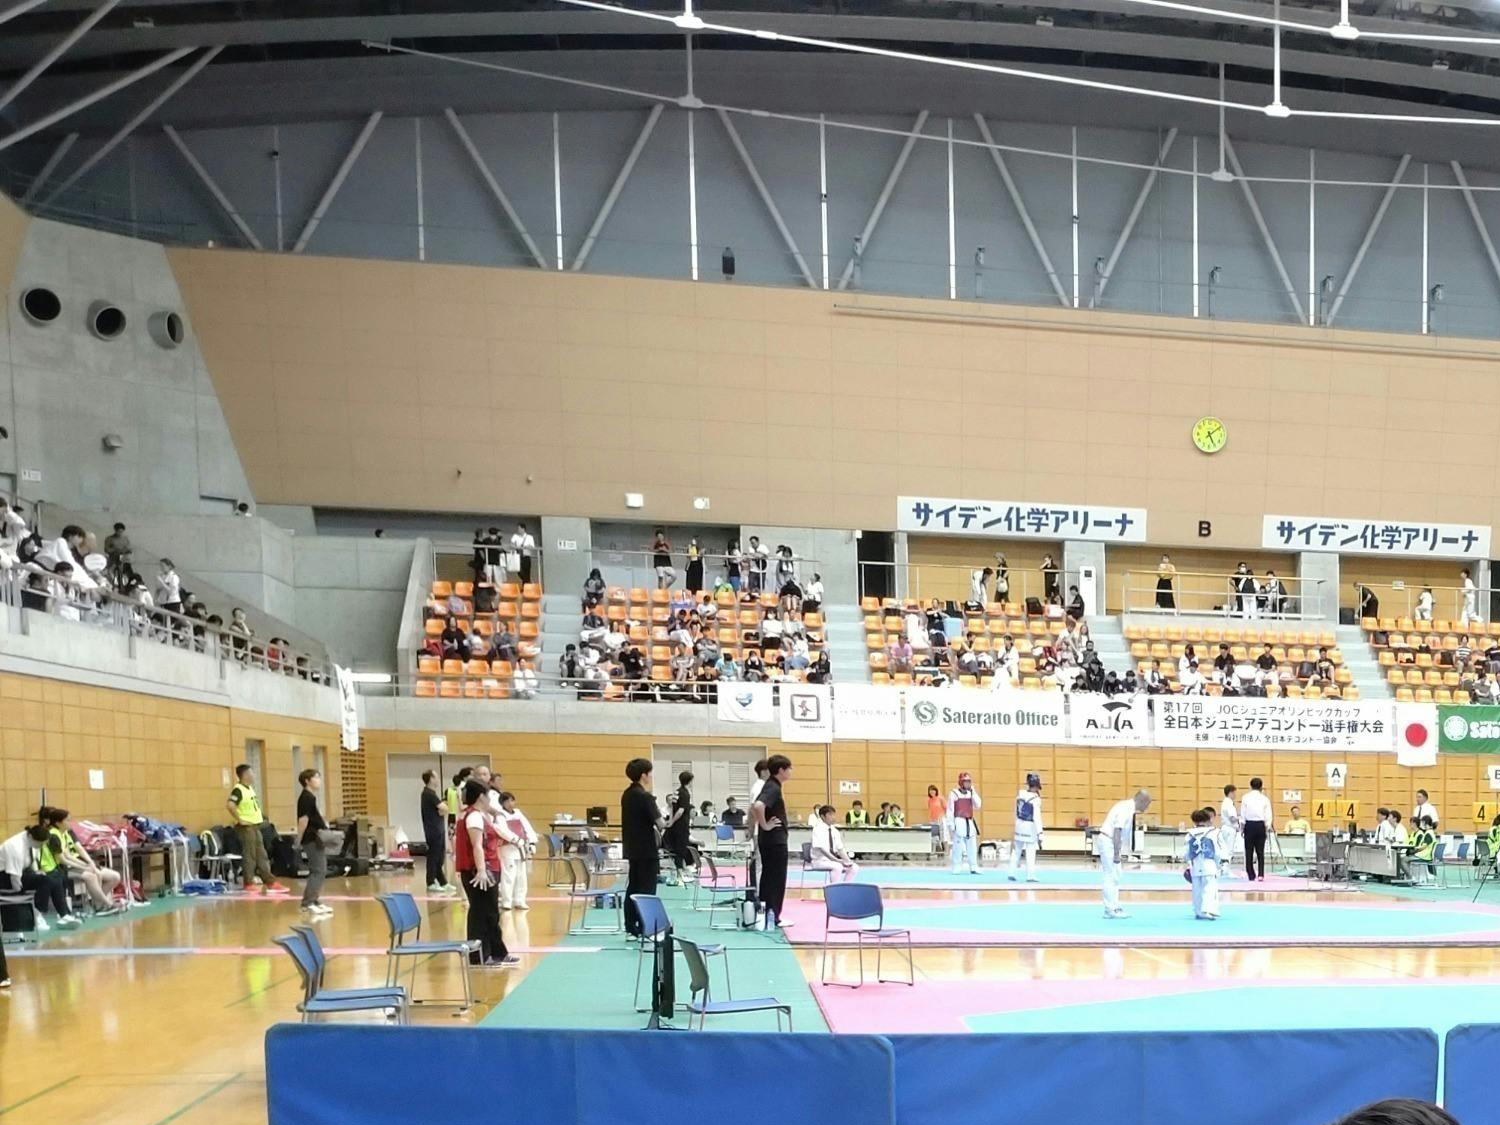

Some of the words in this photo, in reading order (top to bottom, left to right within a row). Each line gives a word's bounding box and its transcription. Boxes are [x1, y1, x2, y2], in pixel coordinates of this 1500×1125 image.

[912, 501, 1134, 536] サイデン化学アリーナ
[1199, 521, 1211, 537] B
[1276, 520, 1479, 553] サイデン化学アリーナ
[1163, 701, 1203, 714] 第17回
[943, 707, 1011, 726] Sateraito
[1016, 708, 1058, 727] Office
[1163, 715, 1384, 734] 全日本ジュニアテコンドー選手権大会
[1332, 768, 1341, 778] A
[1316, 803, 1324, 818] 4
[1347, 803, 1355, 819] 4
[1477, 805, 1485, 821] 4
